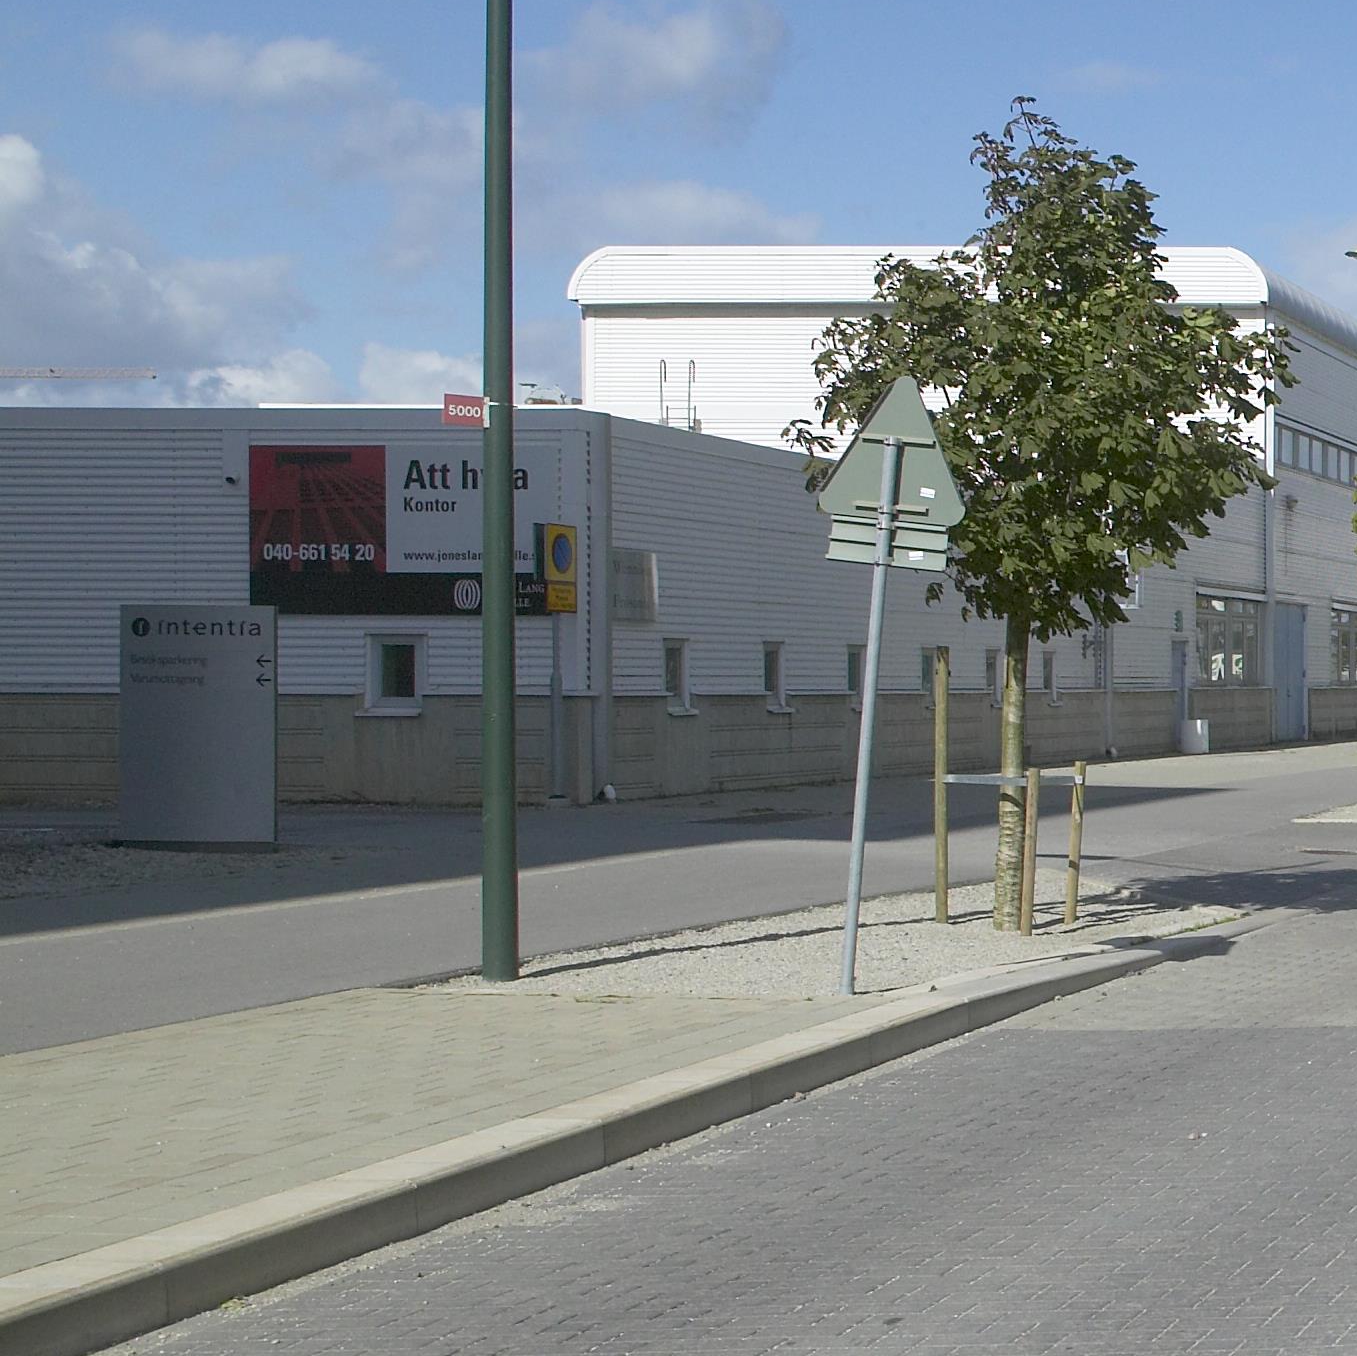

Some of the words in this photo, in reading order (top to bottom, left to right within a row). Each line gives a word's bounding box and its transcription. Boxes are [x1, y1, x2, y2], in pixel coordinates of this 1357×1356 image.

[448, 404, 481, 418] 5000
[403, 459, 451, 490] Att
[462, 459, 529, 490] ha
[403, 496, 457, 513] Kontor
[263, 543, 327, 561] 040-661
[331, 544, 350, 561] 54
[354, 544, 375, 561] 20
[157, 618, 262, 637] intentia
